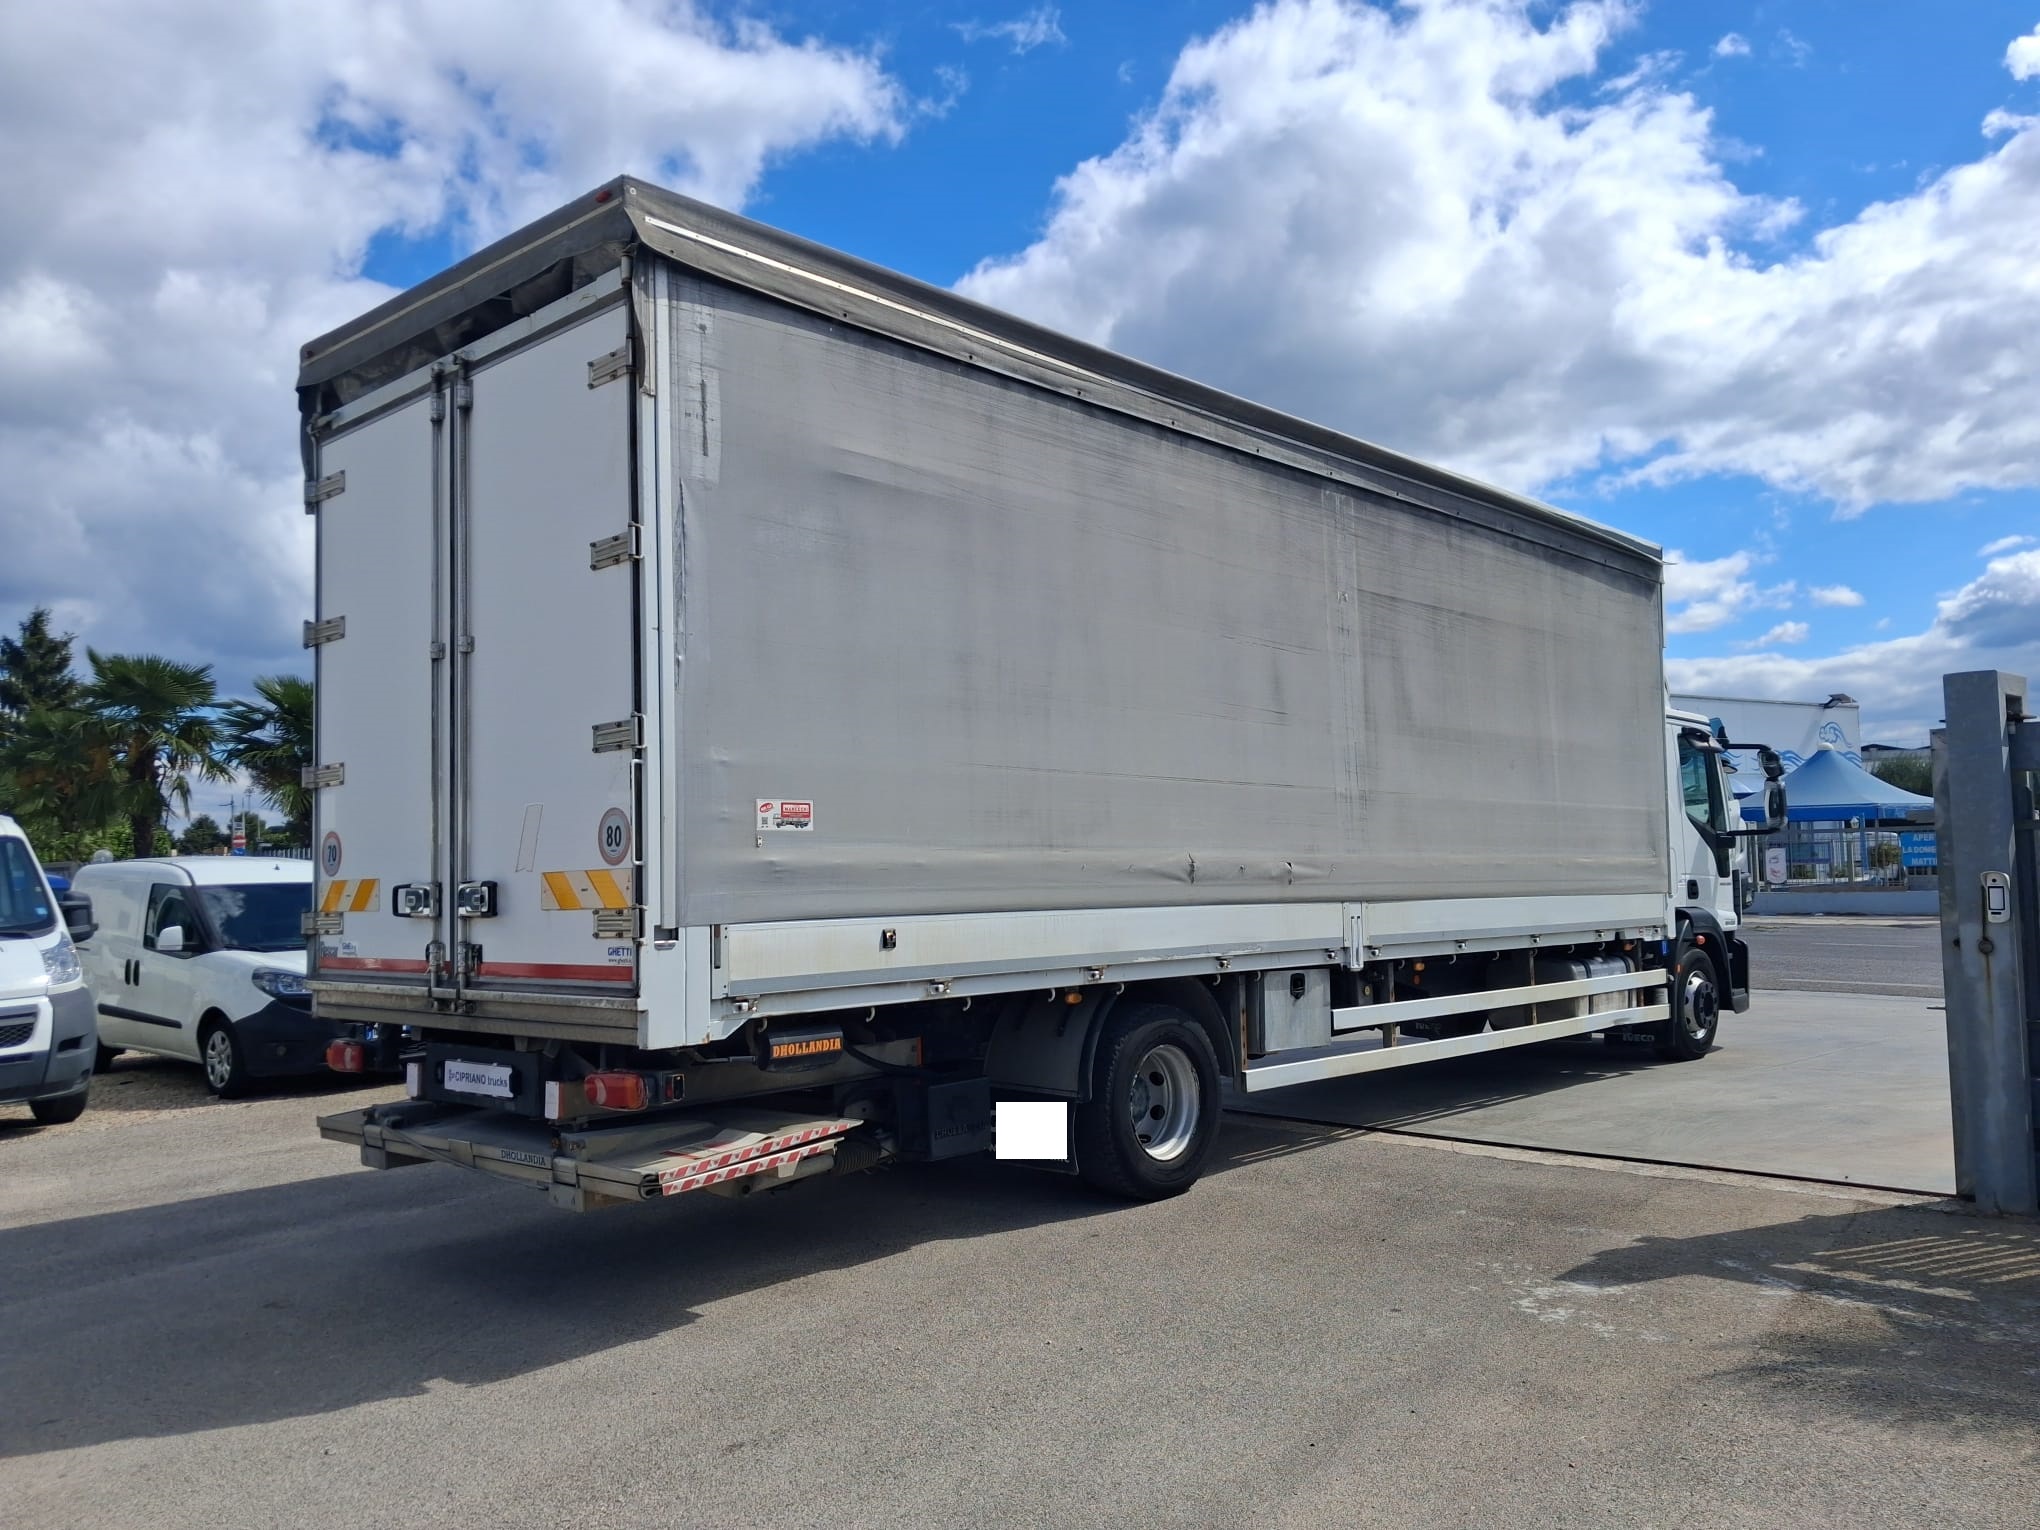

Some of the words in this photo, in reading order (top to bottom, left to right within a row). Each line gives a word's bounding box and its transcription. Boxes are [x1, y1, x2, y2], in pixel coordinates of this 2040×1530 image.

[606, 825, 622, 847] 80
[327, 844, 337, 864] 70
[608, 947, 632, 956] GHETTI
[1622, 1033, 1656, 1042] IVECO
[772, 1037, 842, 1057] DHOLLANDIA
[455, 1072, 486, 1085] CIPRIANO
[488, 1076, 508, 1088] trucks
[501, 1150, 546, 1166] DHOLLANDIA
